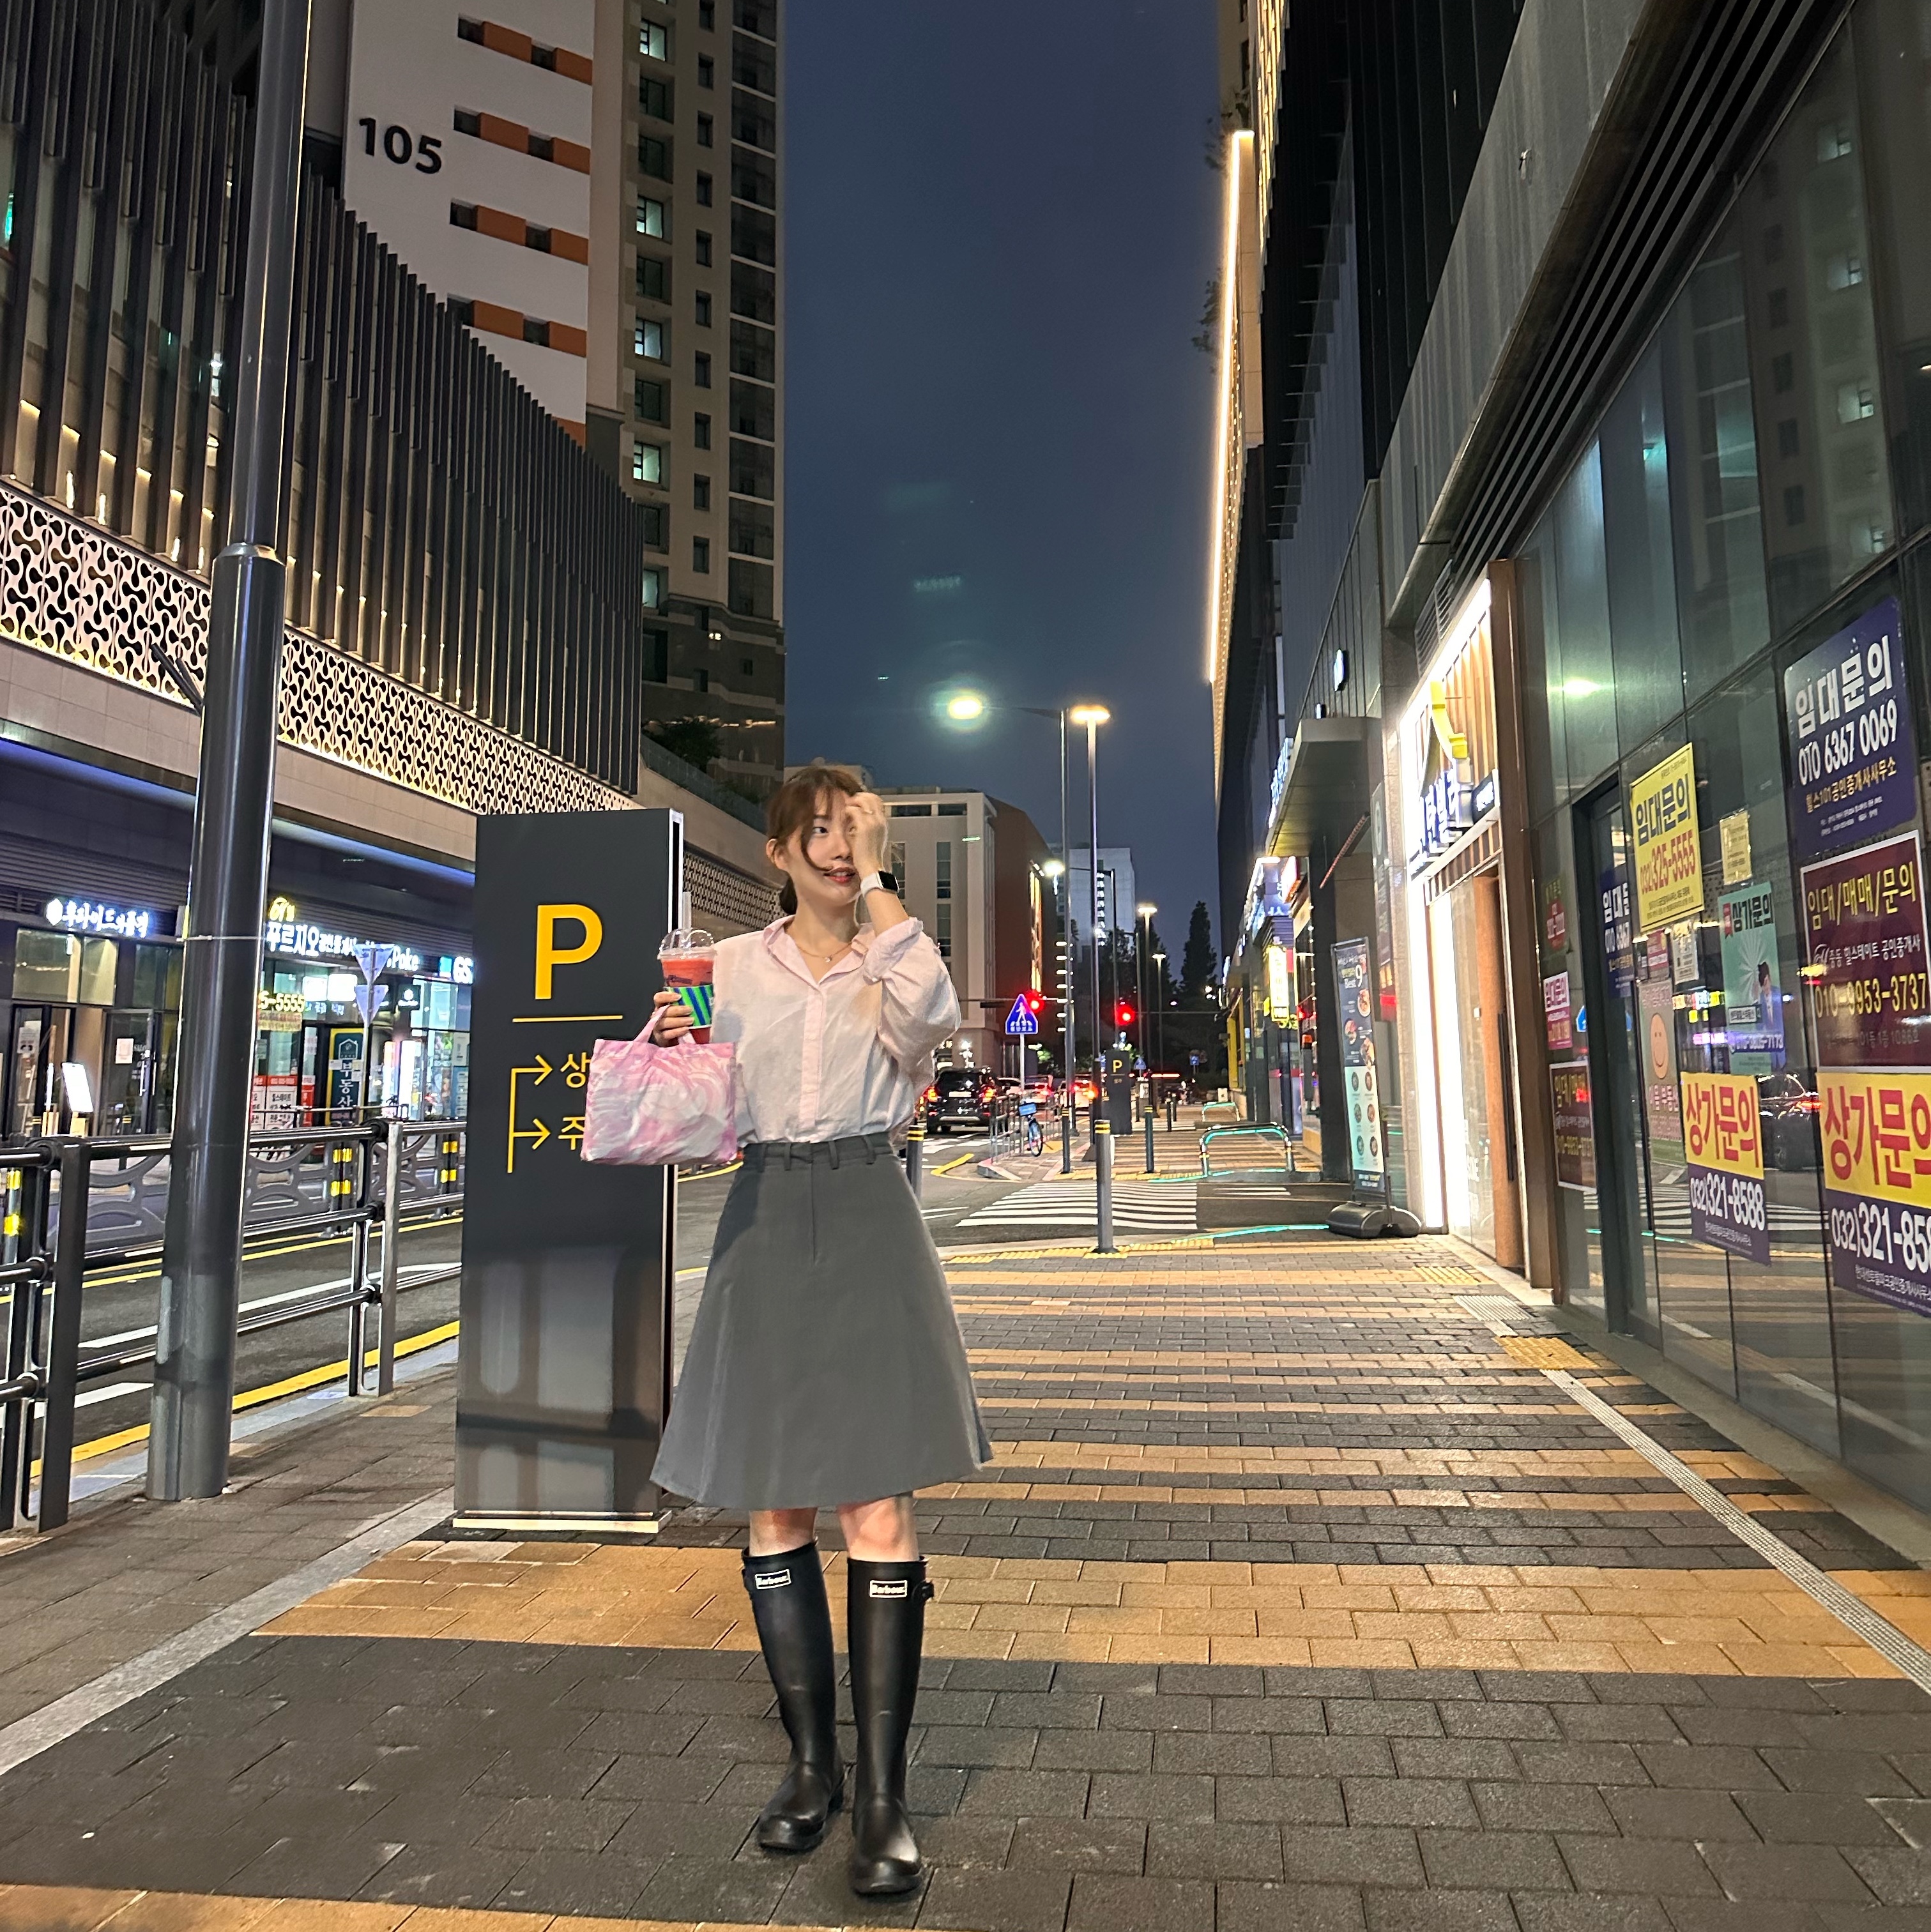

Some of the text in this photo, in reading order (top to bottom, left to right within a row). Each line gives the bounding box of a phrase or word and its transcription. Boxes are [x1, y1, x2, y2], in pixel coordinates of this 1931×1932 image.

[359, 118, 442, 174] 105
[1796, 635, 1892, 739] 임대문의
[1798, 699, 1897, 786] 010 6367 0069
[1636, 773, 1691, 847] 임대문의
[1732, 892, 1774, 932] 상가문의
[1808, 861, 1916, 931] 임대/매매/문의
[266, 921, 319, 957] 푸르지오
[535, 904, 603, 1000] P
[1829, 934, 1921, 968] 중동 힐스테이트 공인중개사
[1815, 973, 1927, 1018] 010-9953-3737
[560, 1052, 591, 1088] 상
[1113, 1060, 1122, 1073] P
[558, 1116, 585, 1150] 주
[1686, 1082, 1759, 1169] 상가문의
[1824, 1085, 1931, 1189] 상가문의
[1690, 1172, 1765, 1231] 032)321-8588
